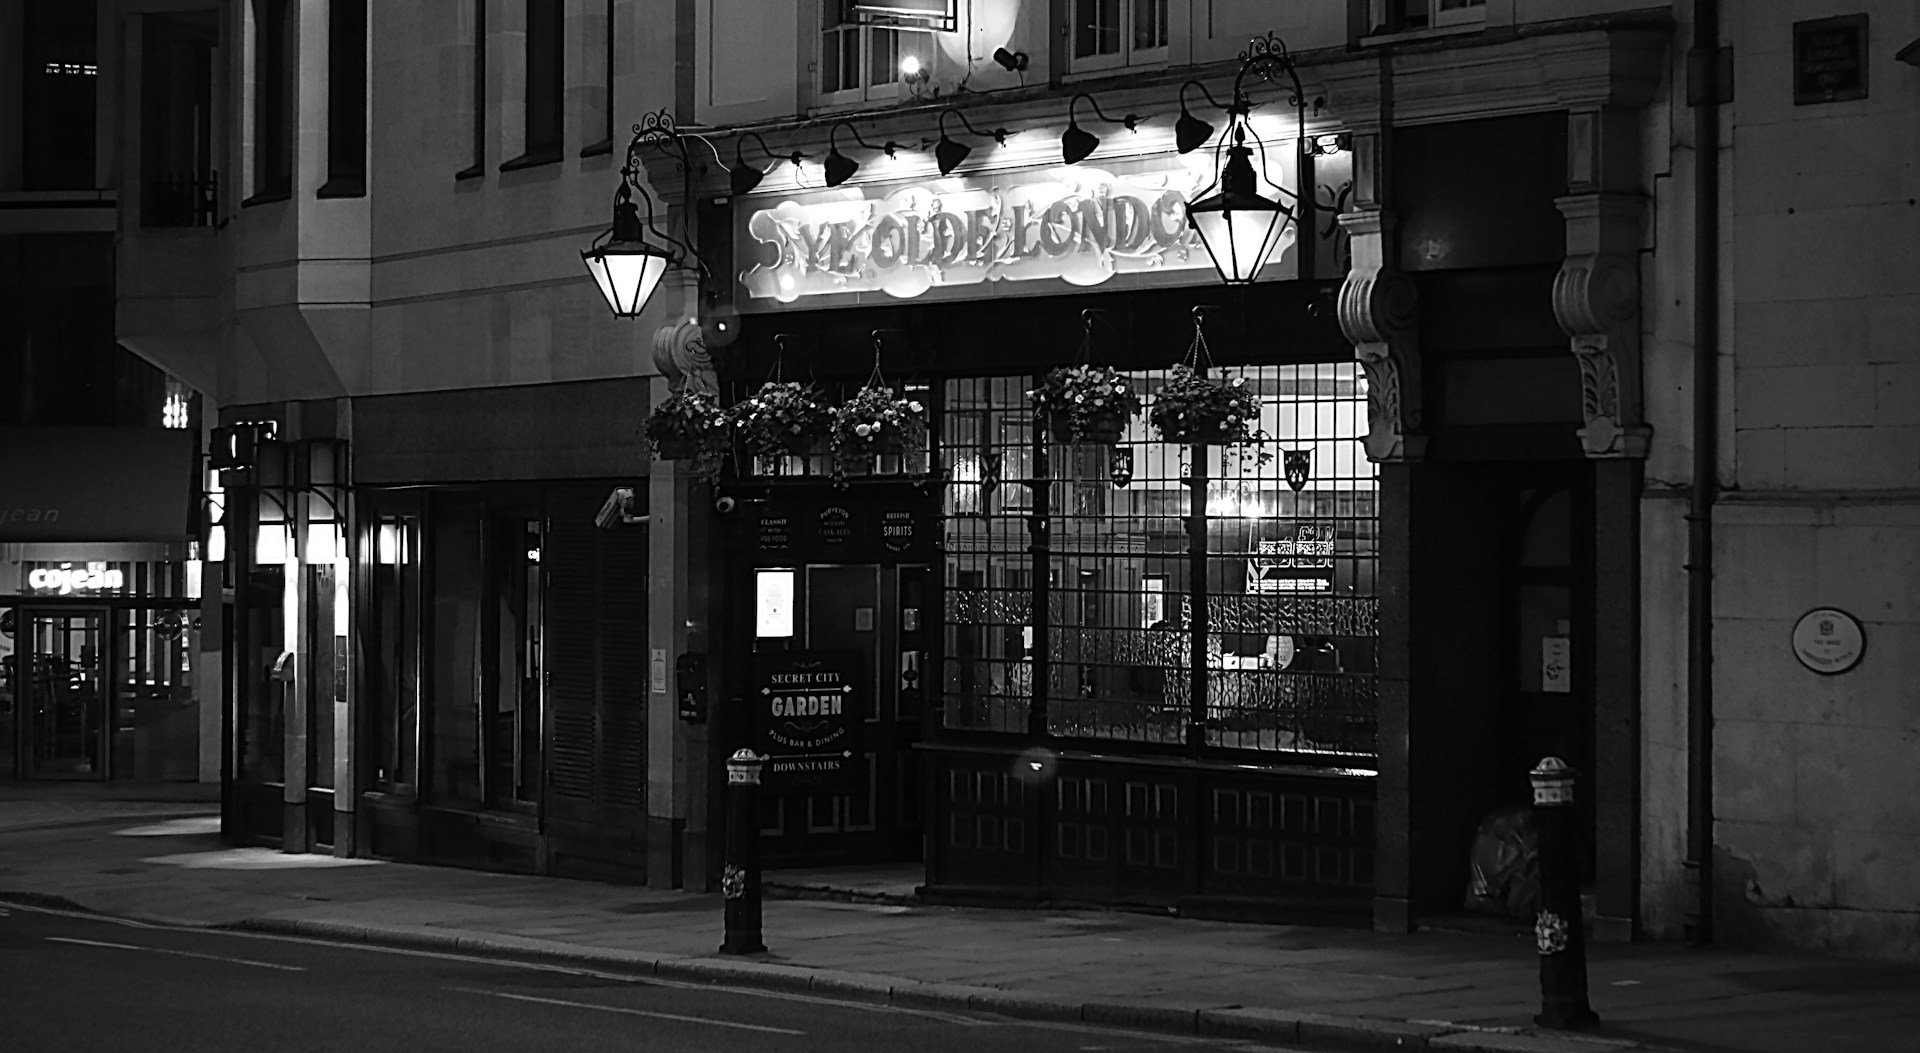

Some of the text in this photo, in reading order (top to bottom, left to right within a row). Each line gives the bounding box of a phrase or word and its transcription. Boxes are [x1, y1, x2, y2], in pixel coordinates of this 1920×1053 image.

[799, 189, 1201, 278] YE OLDE LONDO
[820, 506, 849, 520] PURVEYOR
[883, 526, 913, 537] SPIRITS
[28, 562, 123, 596] cojean
[771, 672, 841, 684] SECRET CITY
[771, 695, 842, 717] GARDEN
[769, 727, 845, 748] PLUS BAR & DINING
[773, 760, 841, 772] DOWNSTAIRS
